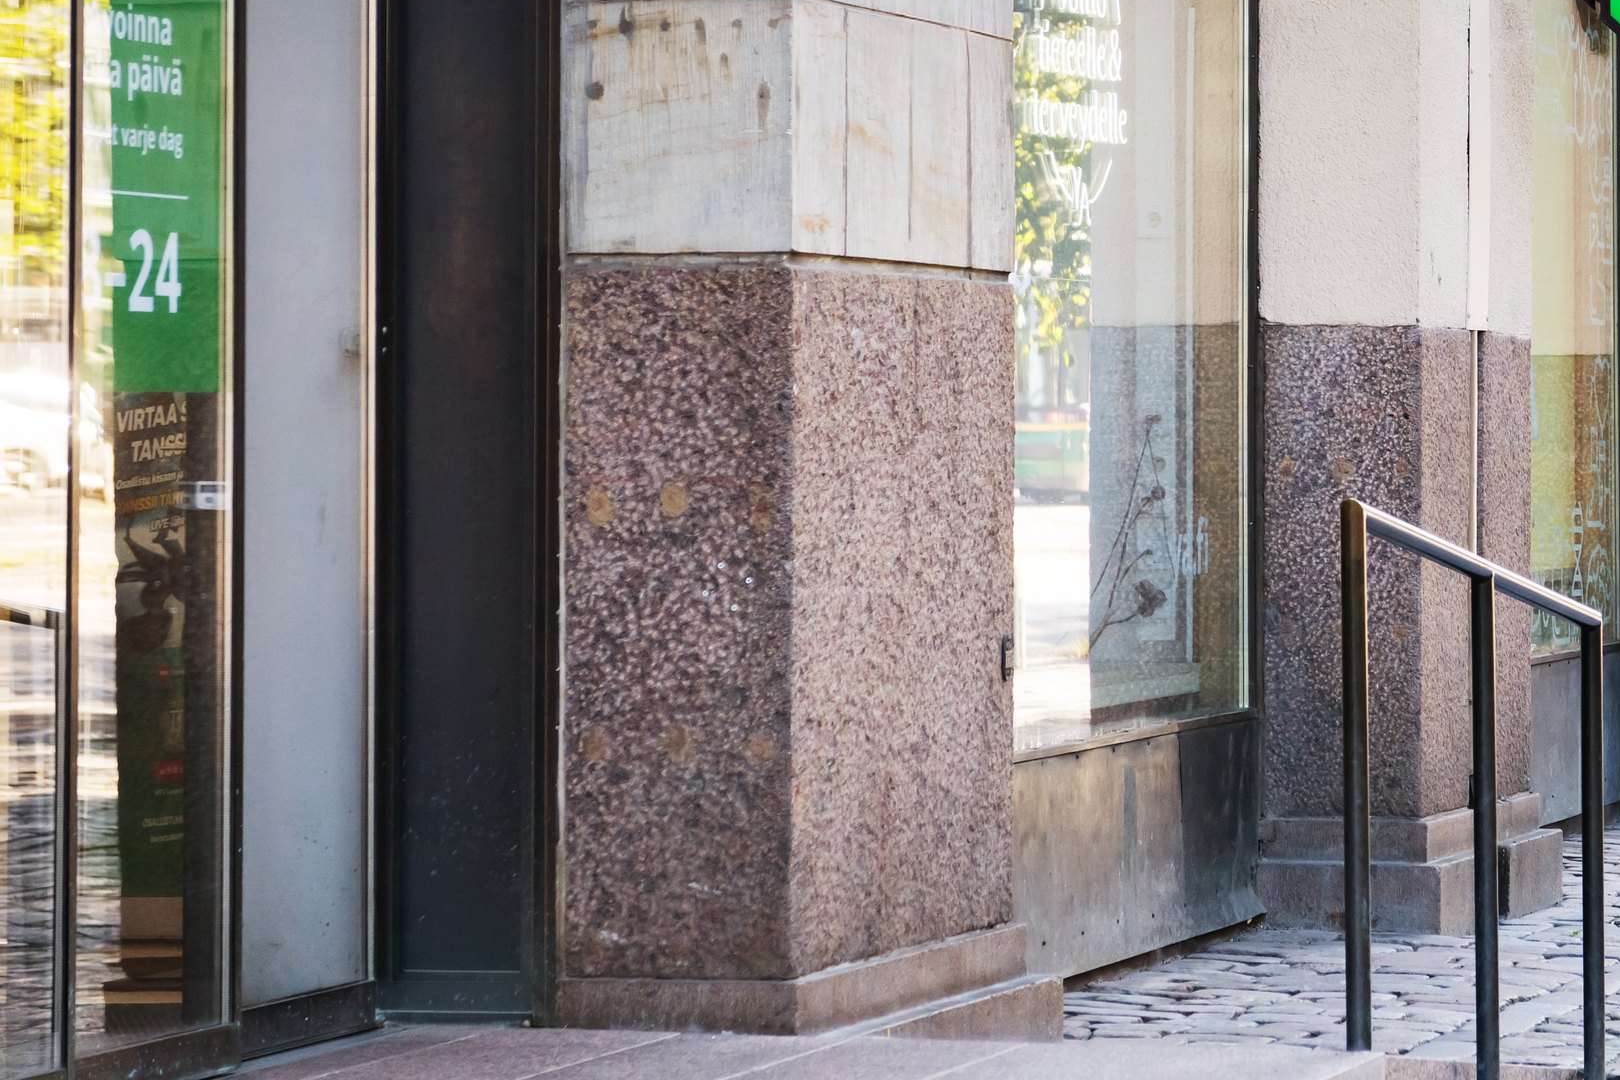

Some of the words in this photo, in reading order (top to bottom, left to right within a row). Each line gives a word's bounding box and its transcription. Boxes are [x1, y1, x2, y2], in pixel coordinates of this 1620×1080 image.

[127, 54, 182, 102] päivä
[120, 124, 156, 156] varje
[158, 125, 184, 159] dag
[116, 403, 178, 433] VIRTAA
[131, 432, 187, 463] TANSS
